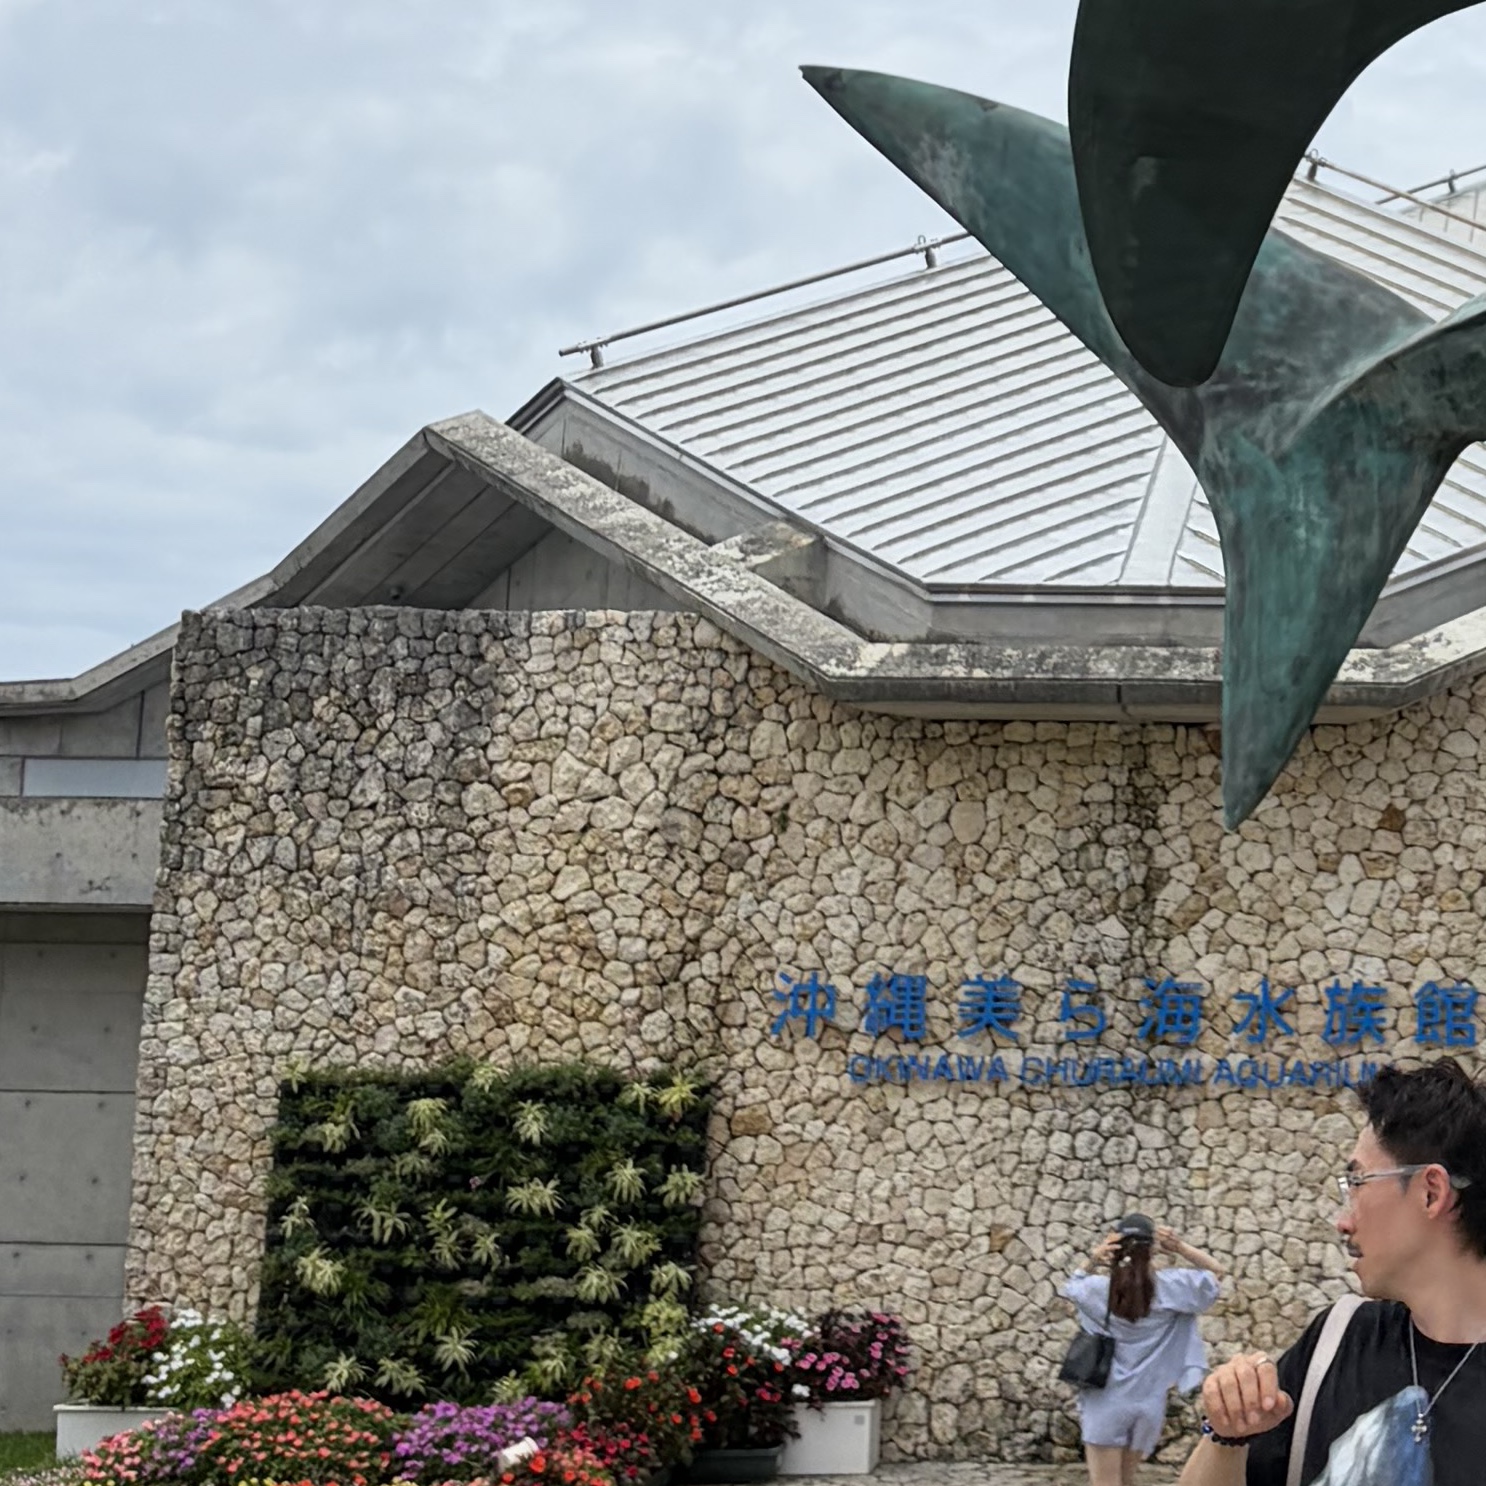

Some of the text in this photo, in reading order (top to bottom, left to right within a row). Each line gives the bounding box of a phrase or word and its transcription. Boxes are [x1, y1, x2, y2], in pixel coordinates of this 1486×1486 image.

[771, 971, 1479, 1047] 沖縄美ら海水族館
[849, 1055, 1009, 1084] OKINAWA
[1020, 1056, 1204, 1087] CHURAUMI
